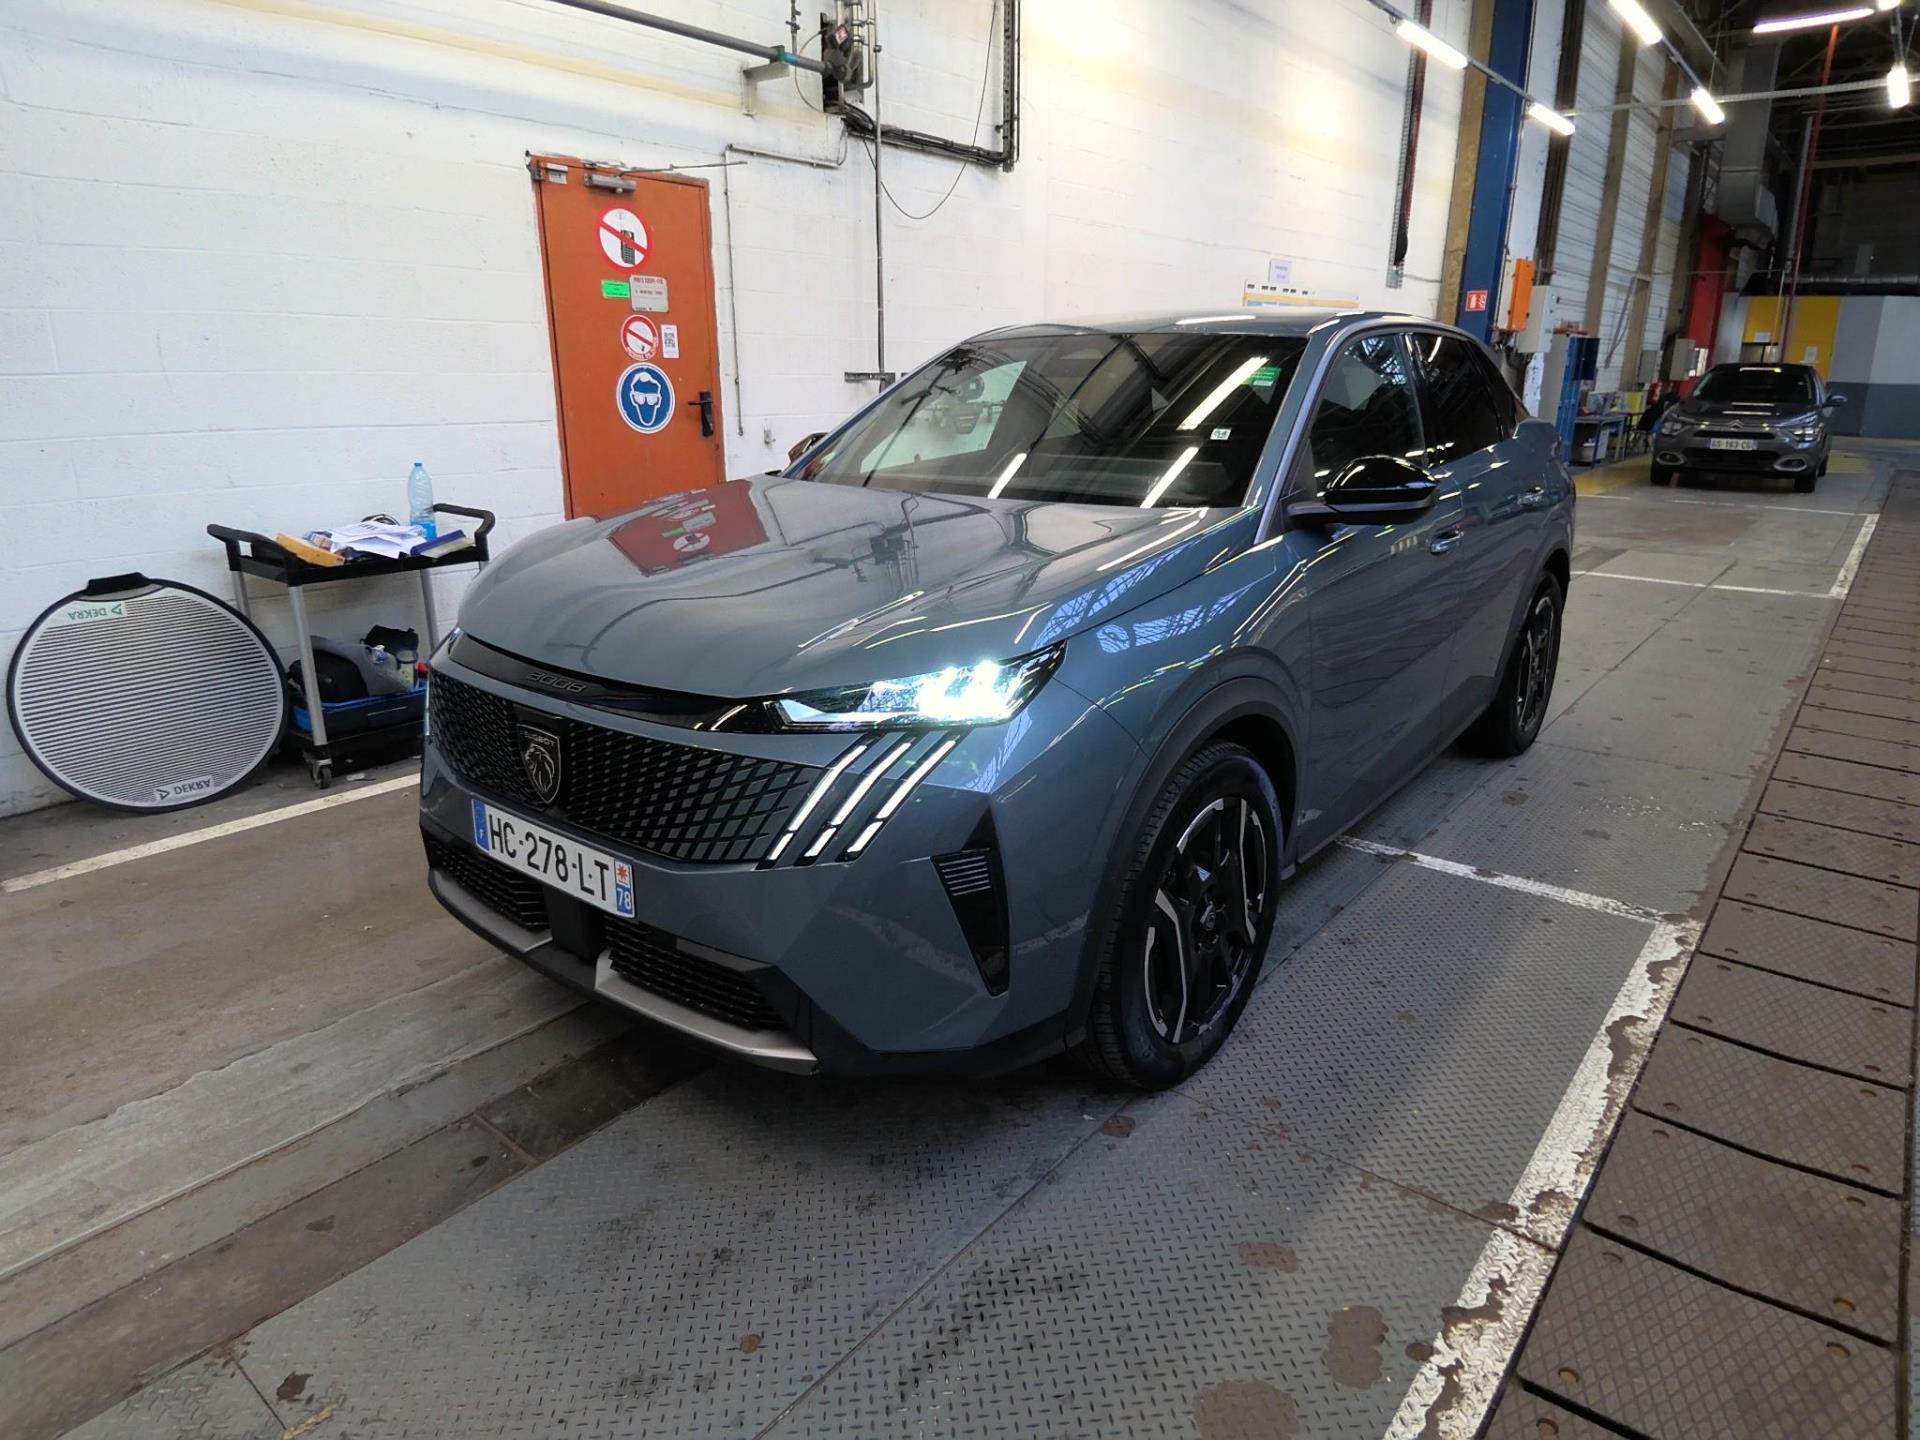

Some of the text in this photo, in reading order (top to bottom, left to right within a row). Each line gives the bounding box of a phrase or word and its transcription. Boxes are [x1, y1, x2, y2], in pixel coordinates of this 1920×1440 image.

[67, 607, 107, 620] DEKRA
[527, 671, 587, 693] 3008
[488, 813, 609, 902] HC-278-LT
[617, 887, 632, 911] 78
